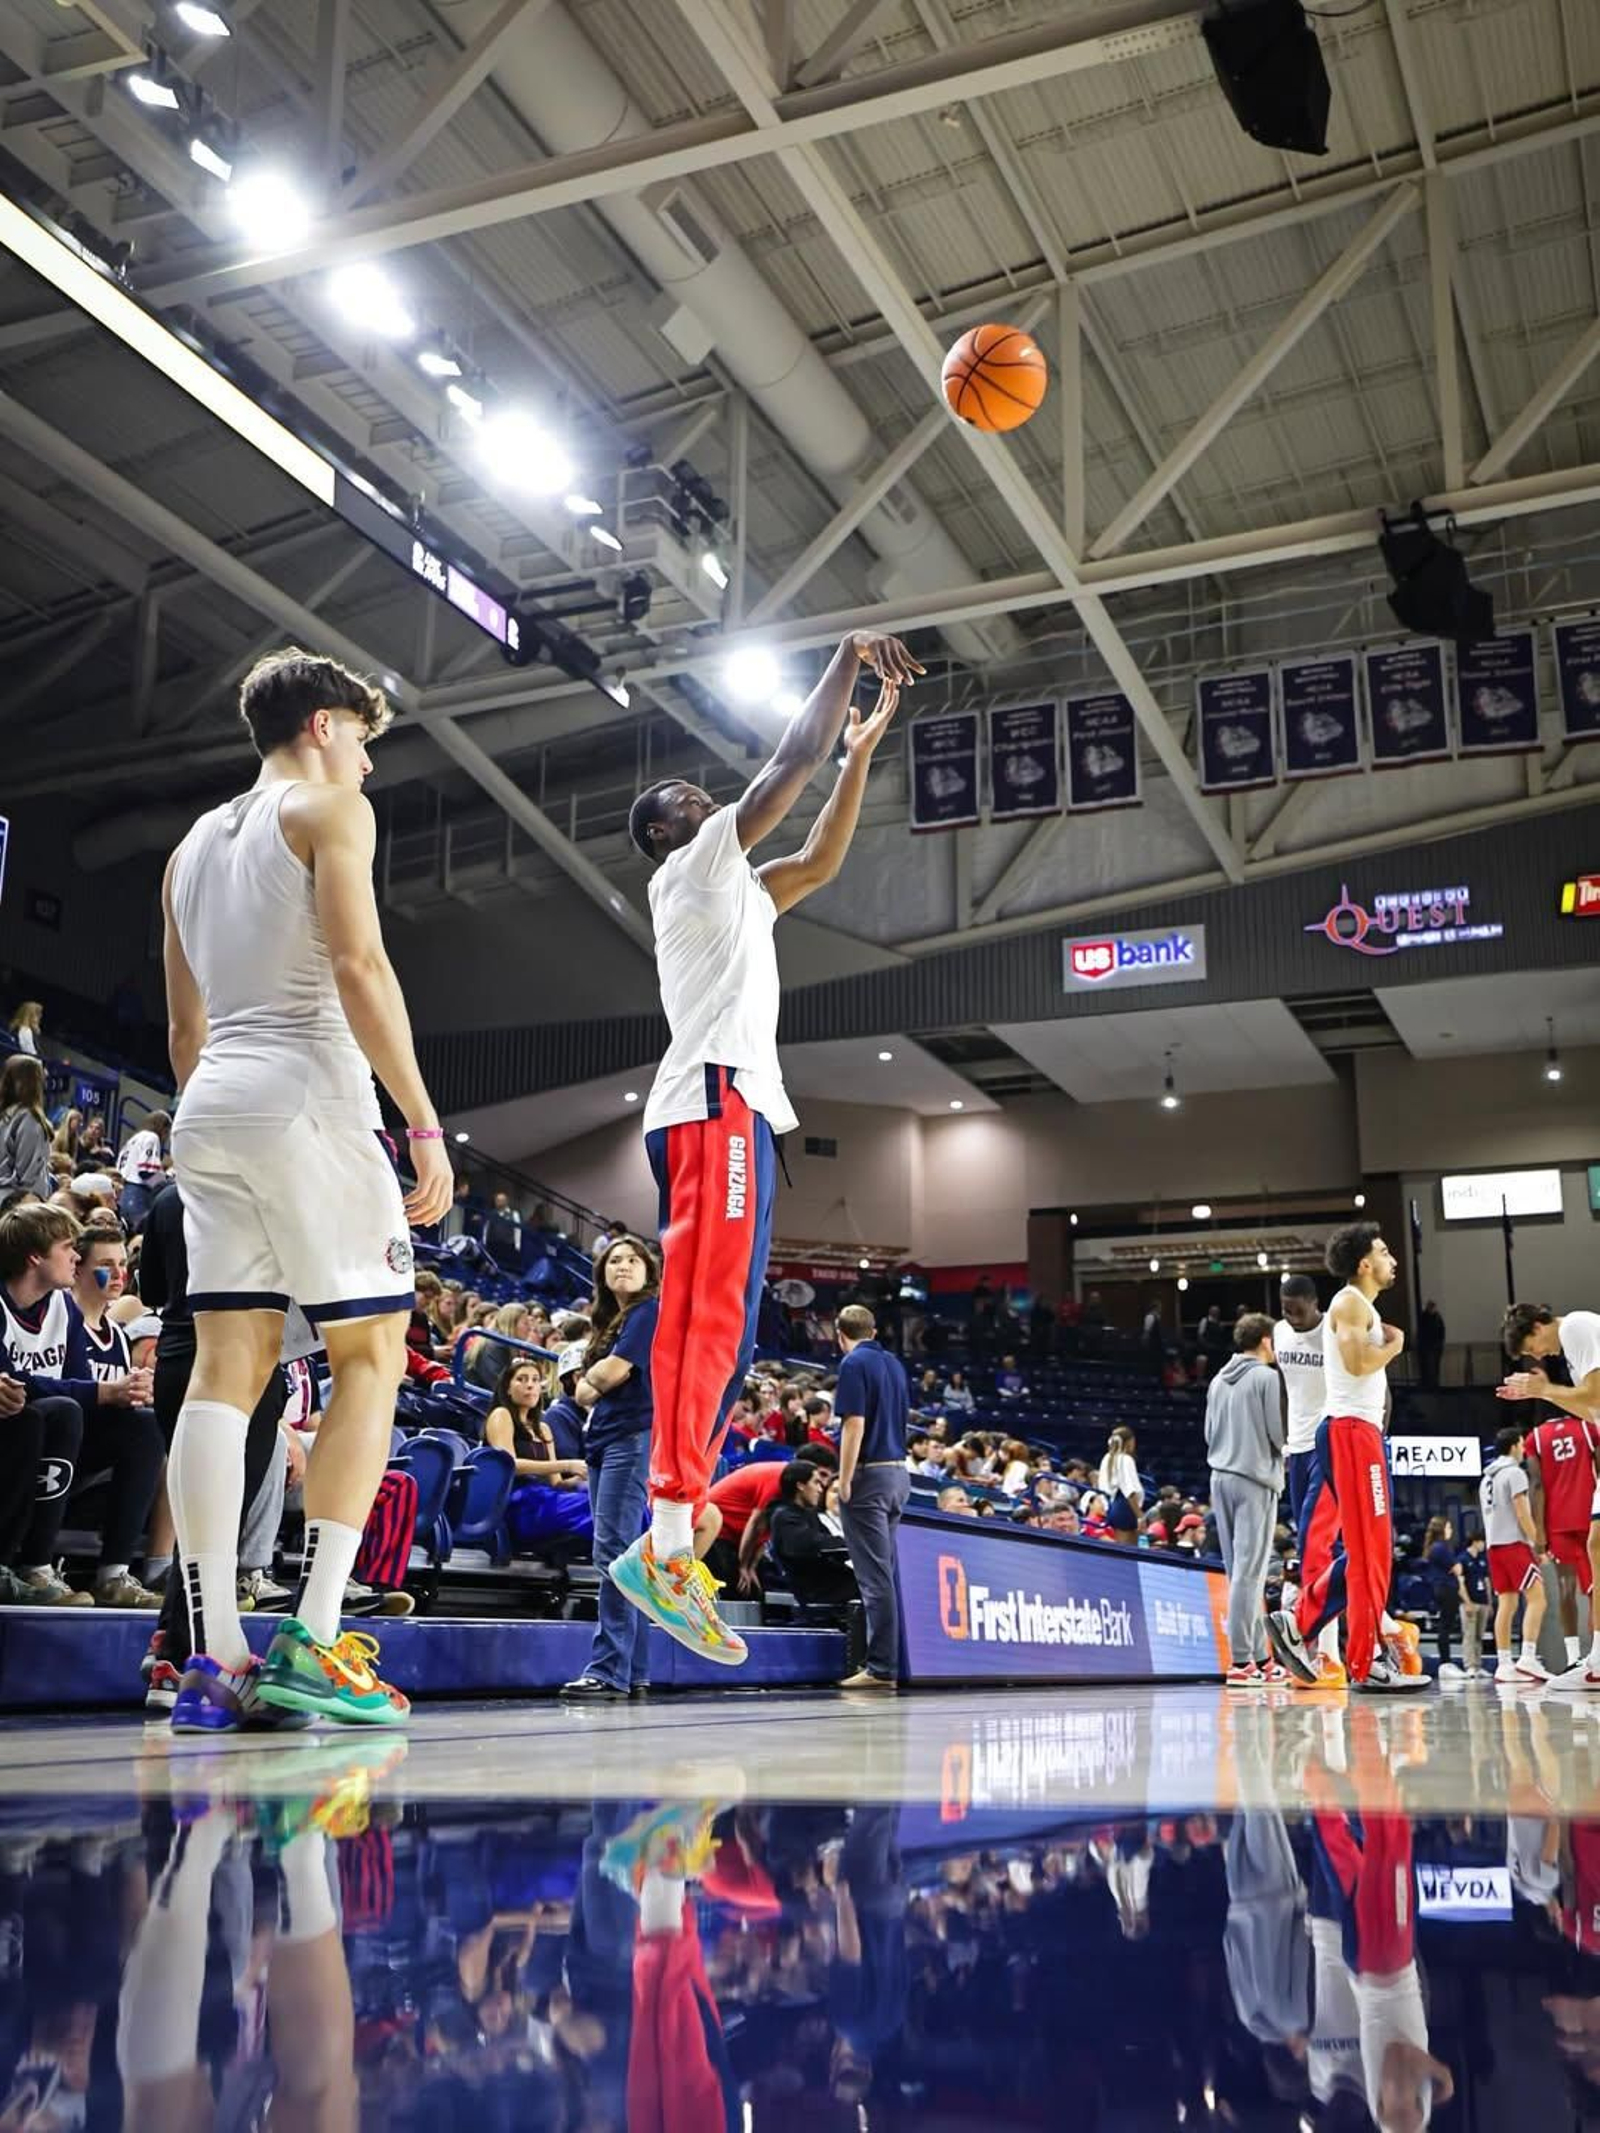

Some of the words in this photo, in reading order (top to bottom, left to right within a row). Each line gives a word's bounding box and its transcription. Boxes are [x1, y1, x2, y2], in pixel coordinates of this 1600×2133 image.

[1310, 899, 1471, 955] QUEST
[1117, 934, 1191, 966] bank
[727, 1135, 746, 1219] GONZAGA
[1396, 1446, 1467, 1462] READY
[1552, 1436, 1576, 1462] 23
[969, 1585, 1018, 1642] First
[1017, 1590, 1102, 1646] Interstate
[1101, 1598, 1134, 1646] Bank
